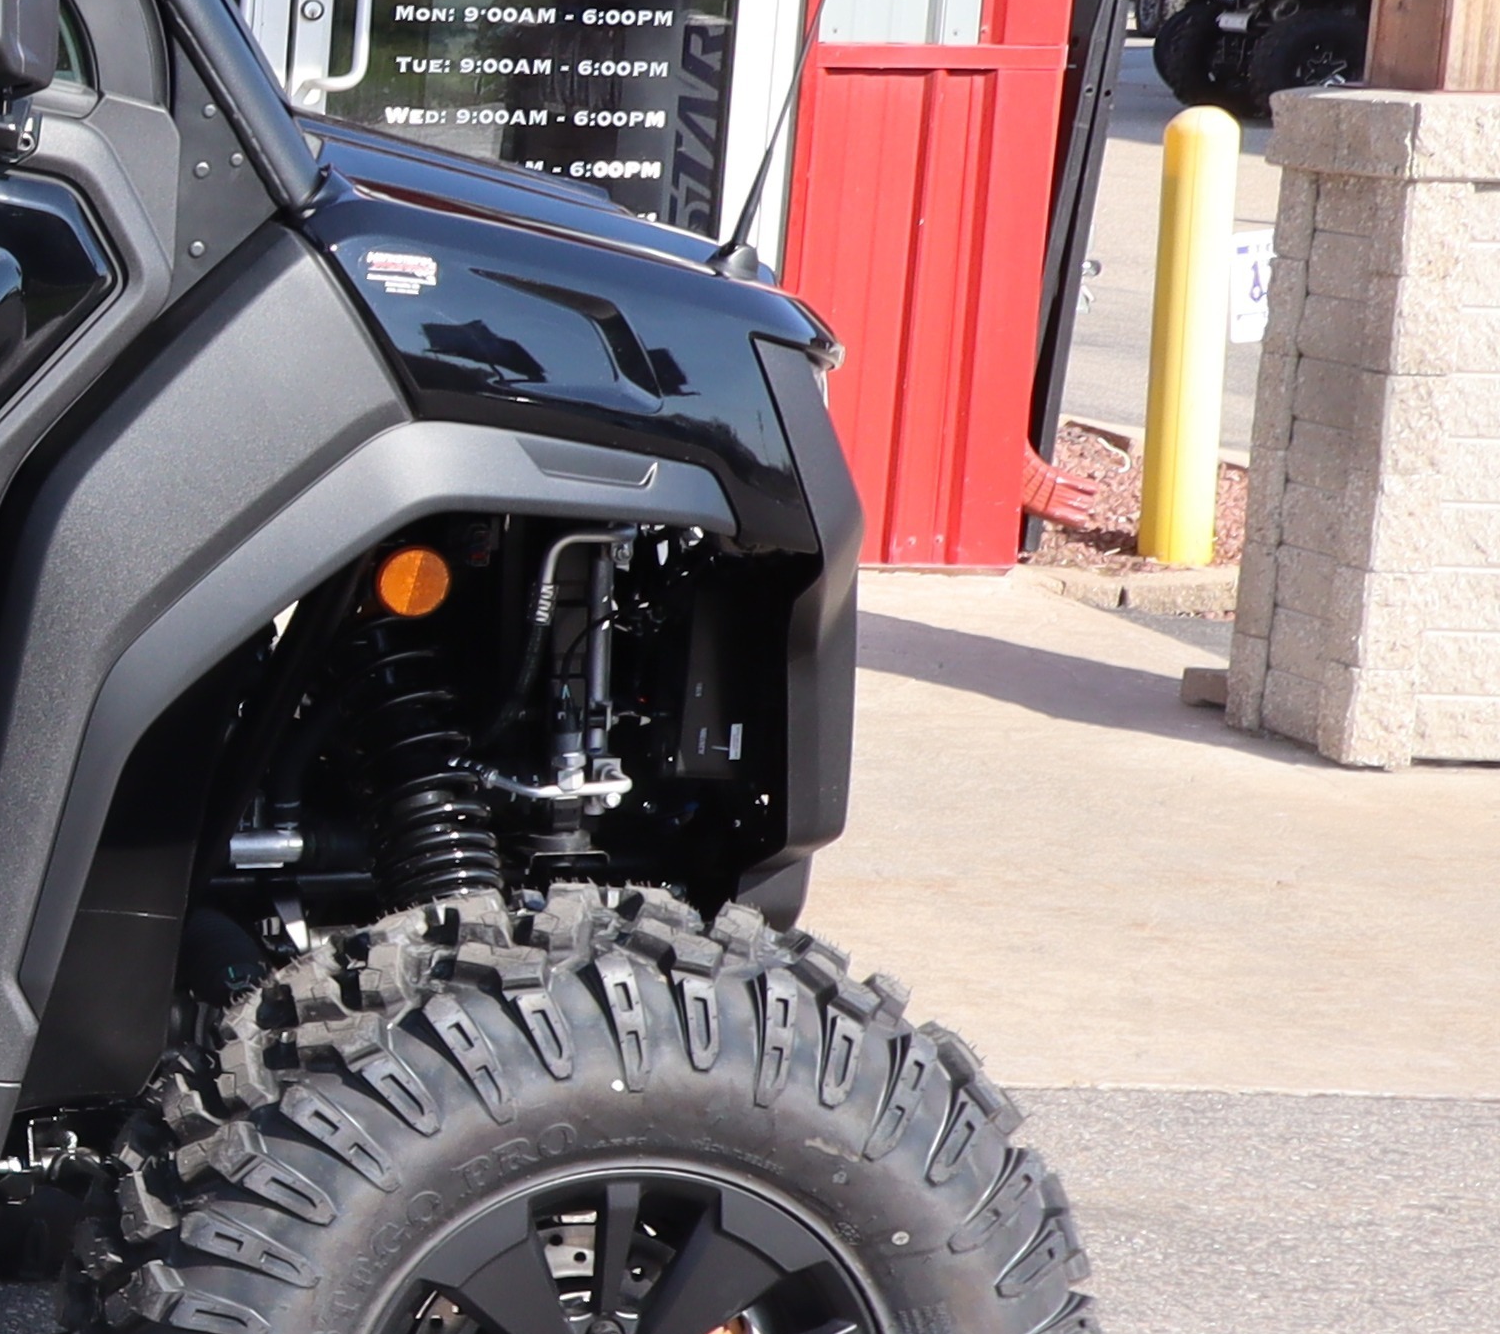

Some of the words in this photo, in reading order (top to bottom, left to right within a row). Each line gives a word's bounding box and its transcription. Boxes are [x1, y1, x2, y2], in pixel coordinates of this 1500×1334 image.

[581, 8, 674, 27] 6:00PM
[459, 58, 552, 76] 9:00AM
[577, 59, 669, 78] 6:00PM
[456, 109, 549, 127] 9:00AM
[573, 110, 666, 129] 6:00PM
[569, 160, 662, 180] 6:00PM
